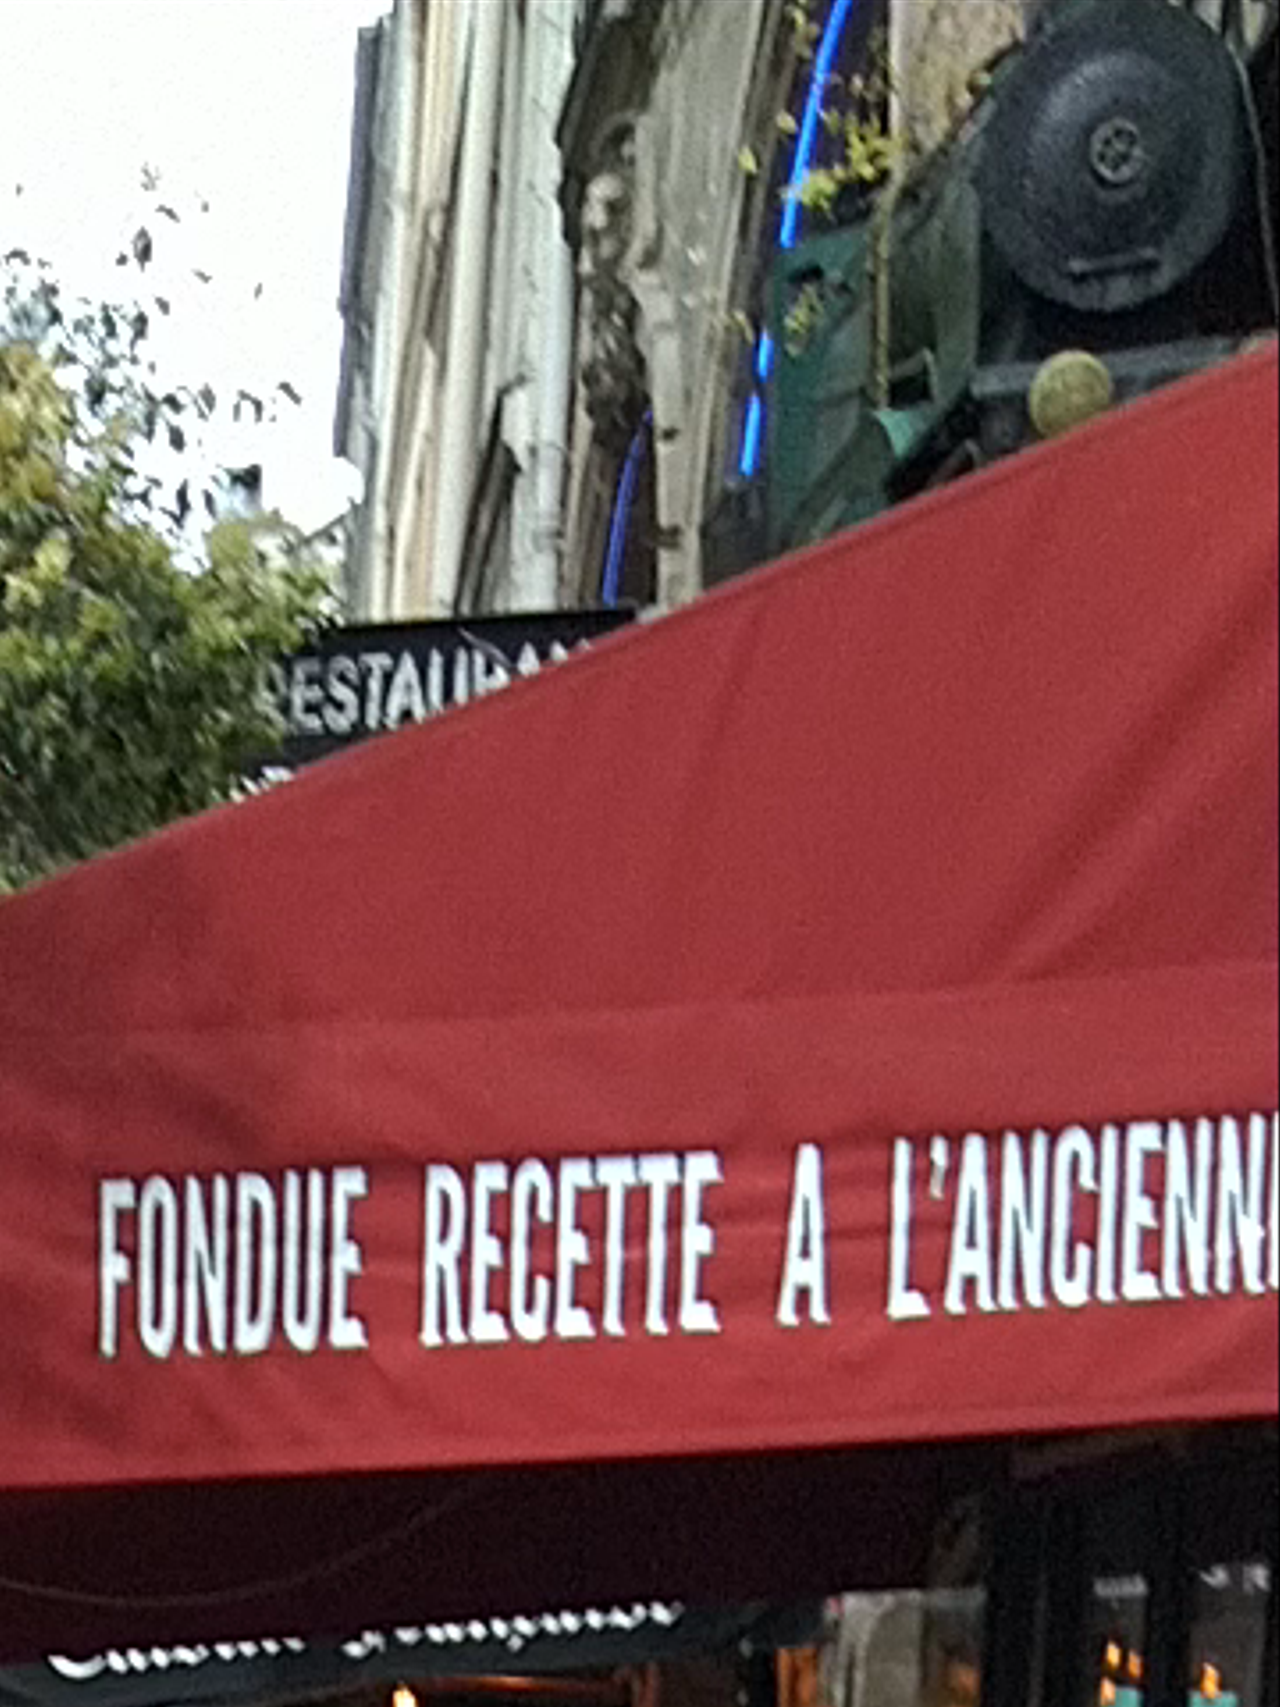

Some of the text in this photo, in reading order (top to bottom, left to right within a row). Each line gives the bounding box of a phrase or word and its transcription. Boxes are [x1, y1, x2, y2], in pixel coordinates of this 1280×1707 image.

[256, 638, 596, 737] RESTAUR
[99, 1112, 1280, 1361] FONDUE RECETTE A L'ANCIENN
